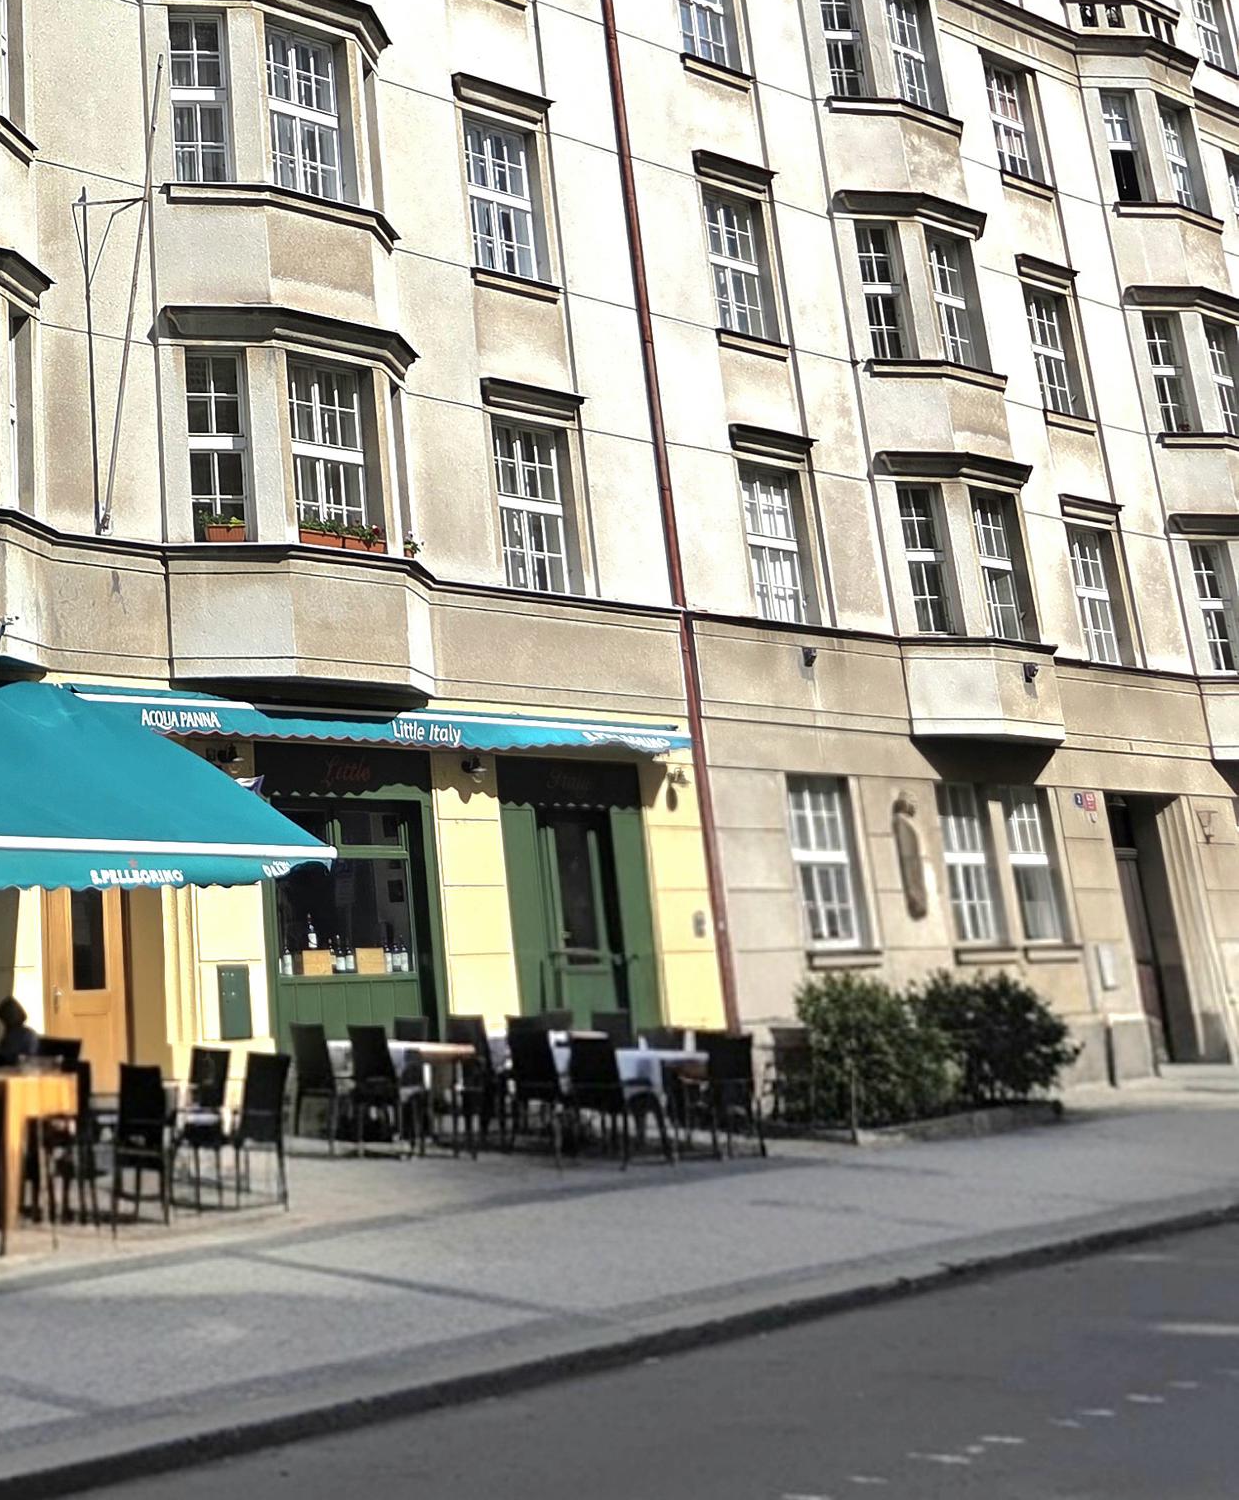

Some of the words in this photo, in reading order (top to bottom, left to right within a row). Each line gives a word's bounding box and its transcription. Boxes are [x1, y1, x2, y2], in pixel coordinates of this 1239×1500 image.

[141, 708, 180, 730] ACQUA
[179, 710, 222, 729] PANNA
[391, 719, 425, 741] Little
[429, 723, 462, 747] Italy
[89, 868, 185, 885] S.PELLEGRINO
